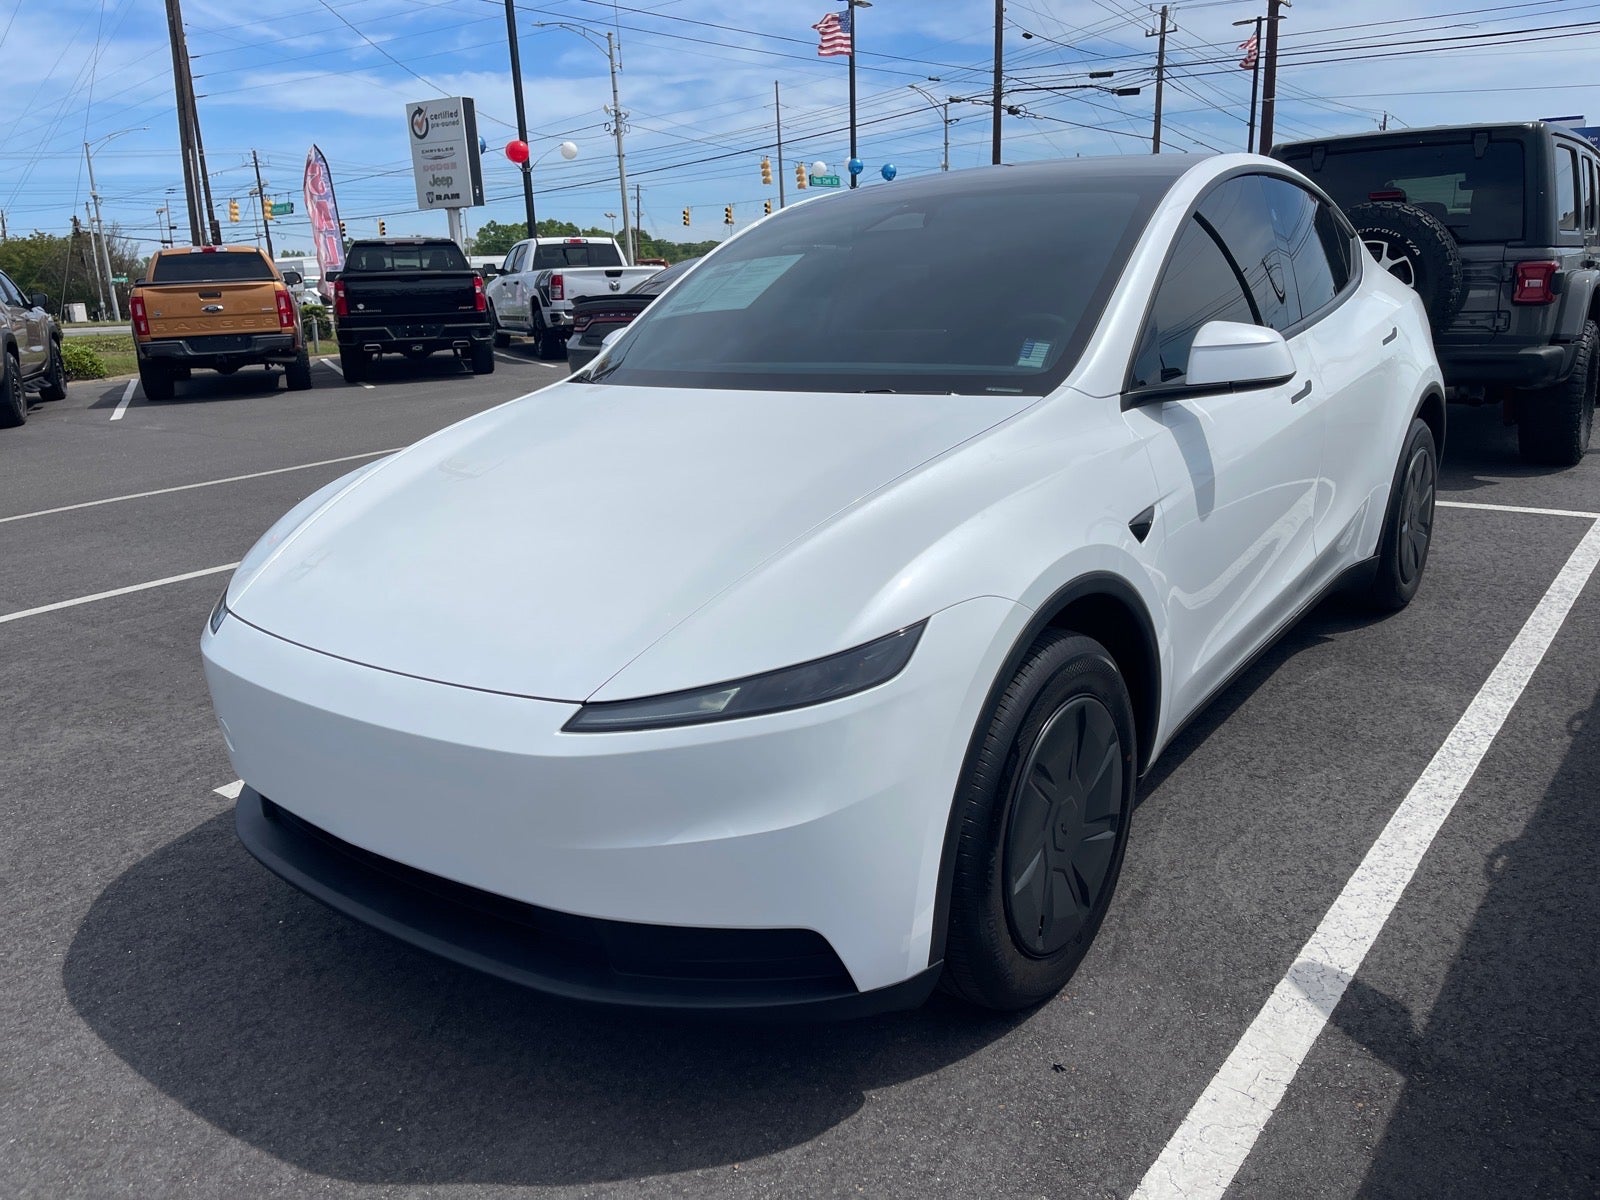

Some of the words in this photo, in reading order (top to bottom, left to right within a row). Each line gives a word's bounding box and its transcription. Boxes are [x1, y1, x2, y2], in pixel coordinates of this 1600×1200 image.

[430, 109, 458, 121] certified
[431, 119, 459, 129] pre-owned
[429, 173, 453, 188] Jeep
[435, 192, 460, 201] RAM
[1358, 227, 1401, 238] errain
[1406, 238, 1421, 256] T/A
[153, 318, 277, 332] RANGER
